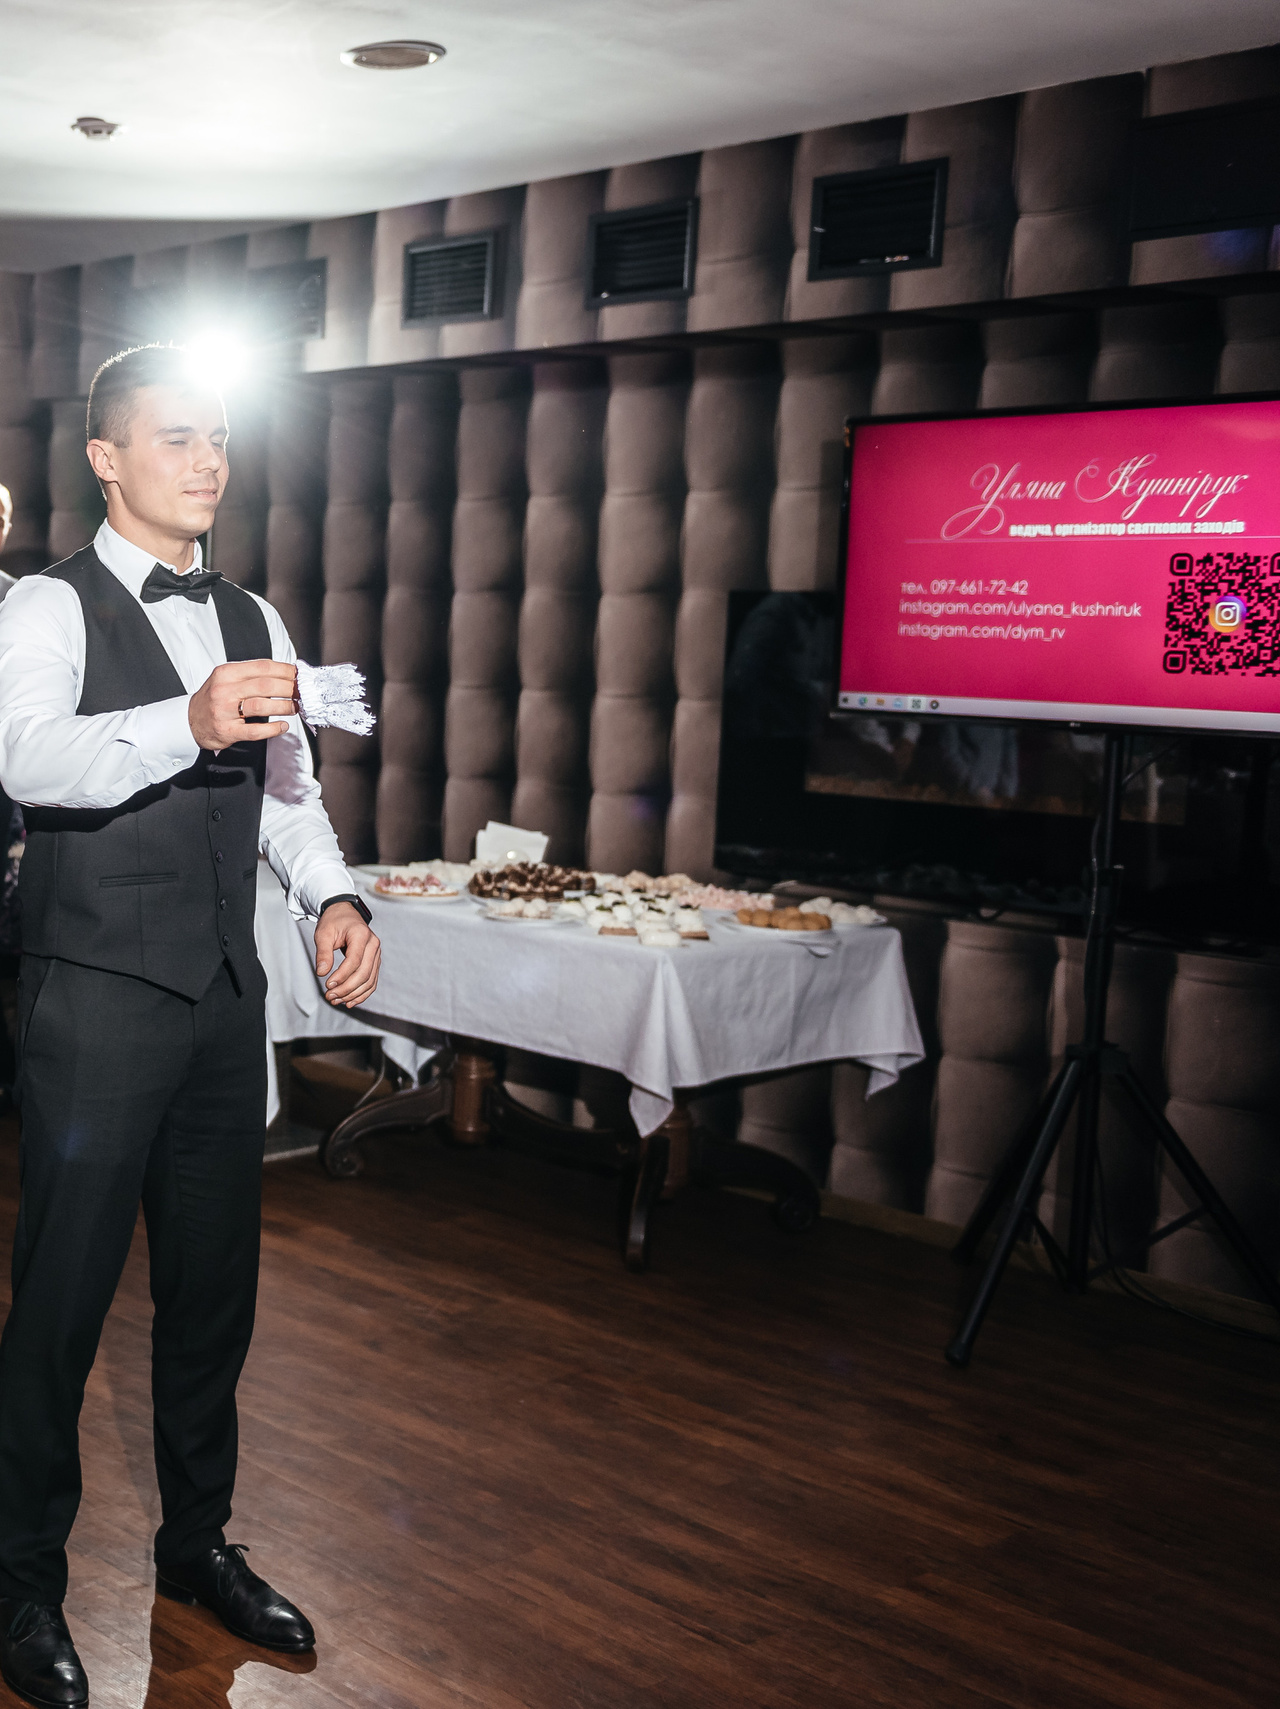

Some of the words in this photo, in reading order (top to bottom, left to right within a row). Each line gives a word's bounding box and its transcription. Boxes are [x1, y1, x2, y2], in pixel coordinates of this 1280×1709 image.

[941, 462, 1066, 541] Уляна
[1075, 453, 1249, 520] Кушнірук
[1055, 521, 1126, 536] організатор
[1127, 522, 1192, 535] святкових
[1193, 519, 1245, 535] заходів
[901, 582, 927, 594] тел.
[930, 580, 1028, 595] 097-661-72-42
[899, 600, 1141, 618] instagram.com/ulyana_kushniruk
[898, 622, 1065, 641] instagram.com/dym_rv
